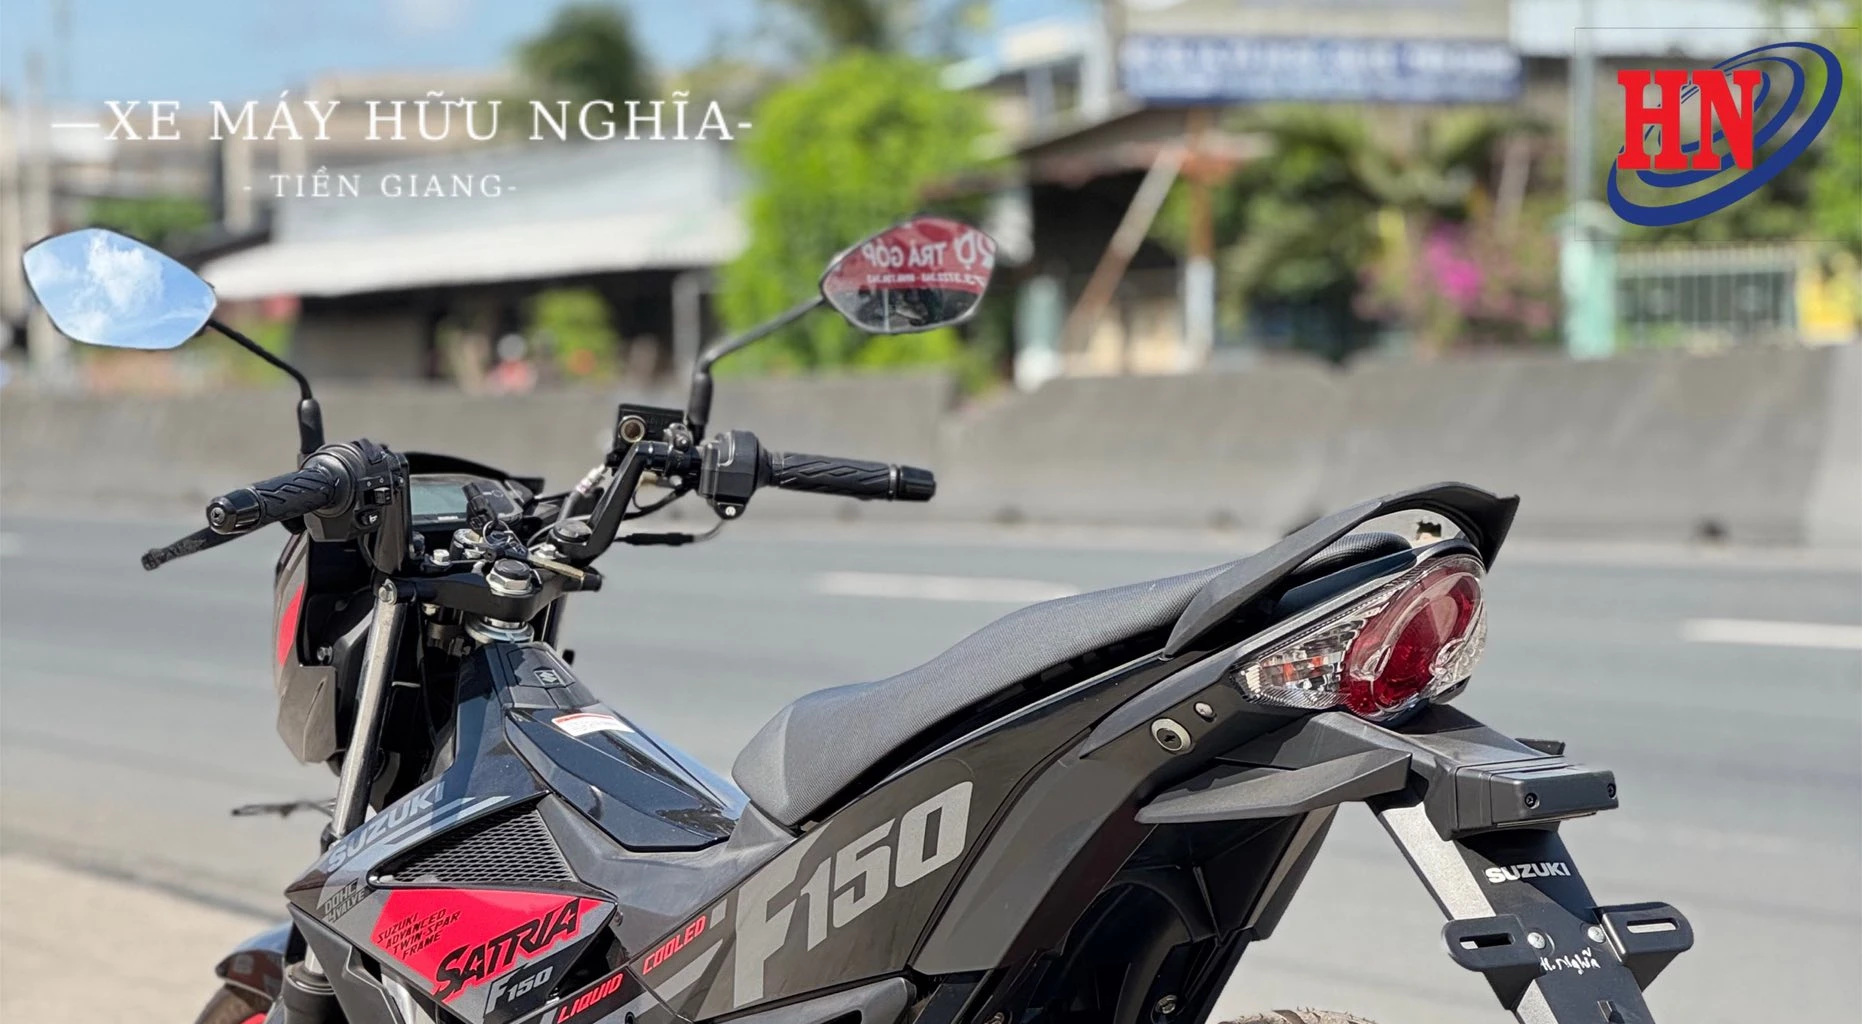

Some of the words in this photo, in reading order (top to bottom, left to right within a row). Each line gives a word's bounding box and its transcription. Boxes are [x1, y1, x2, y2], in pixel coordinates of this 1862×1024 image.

[328, 781, 445, 872] SUZUKI
[734, 781, 973, 1009] F150
[1485, 861, 1571, 884] SUZUKI
[377, 912, 418, 944] SUZUKI
[386, 908, 447, 949] ADVANCED
[402, 929, 443, 960] FRAME
[434, 897, 582, 996] SATRIA
[485, 963, 553, 1015] F150
[557, 974, 624, 1024] LIQUID
[642, 914, 707, 976] COOLED
